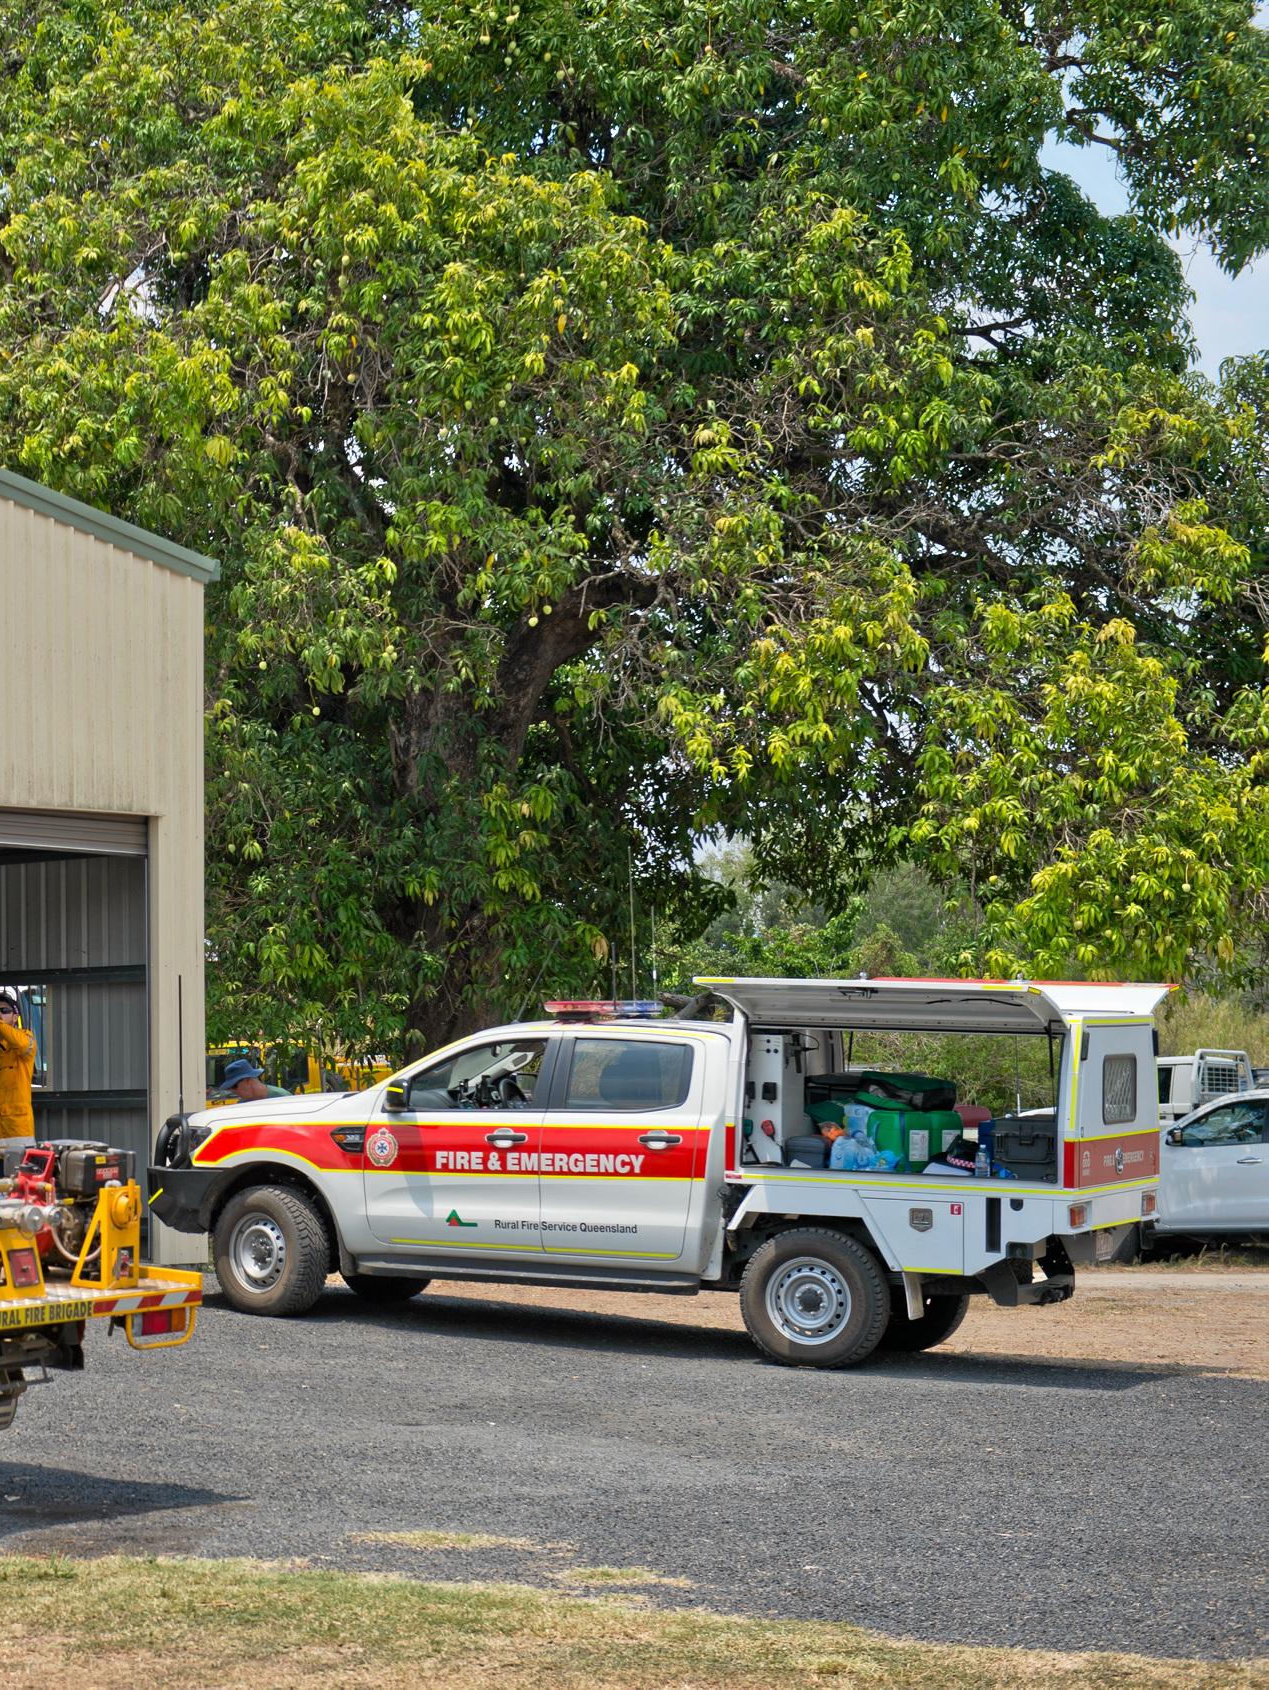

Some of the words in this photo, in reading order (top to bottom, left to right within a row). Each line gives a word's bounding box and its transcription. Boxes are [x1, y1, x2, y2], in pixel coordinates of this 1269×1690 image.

[436, 1151, 484, 1170] FIRE
[488, 1152, 502, 1171] &
[506, 1152, 645, 1174] EMERGENCY
[494, 1219, 519, 1231] Rural
[521, 1220, 539, 1231] Fire
[541, 1221, 578, 1233] Service
[580, 1222, 638, 1234] Queensland
[25, 1306, 46, 1324] FIRE
[49, 1301, 92, 1322] BRIGADE
